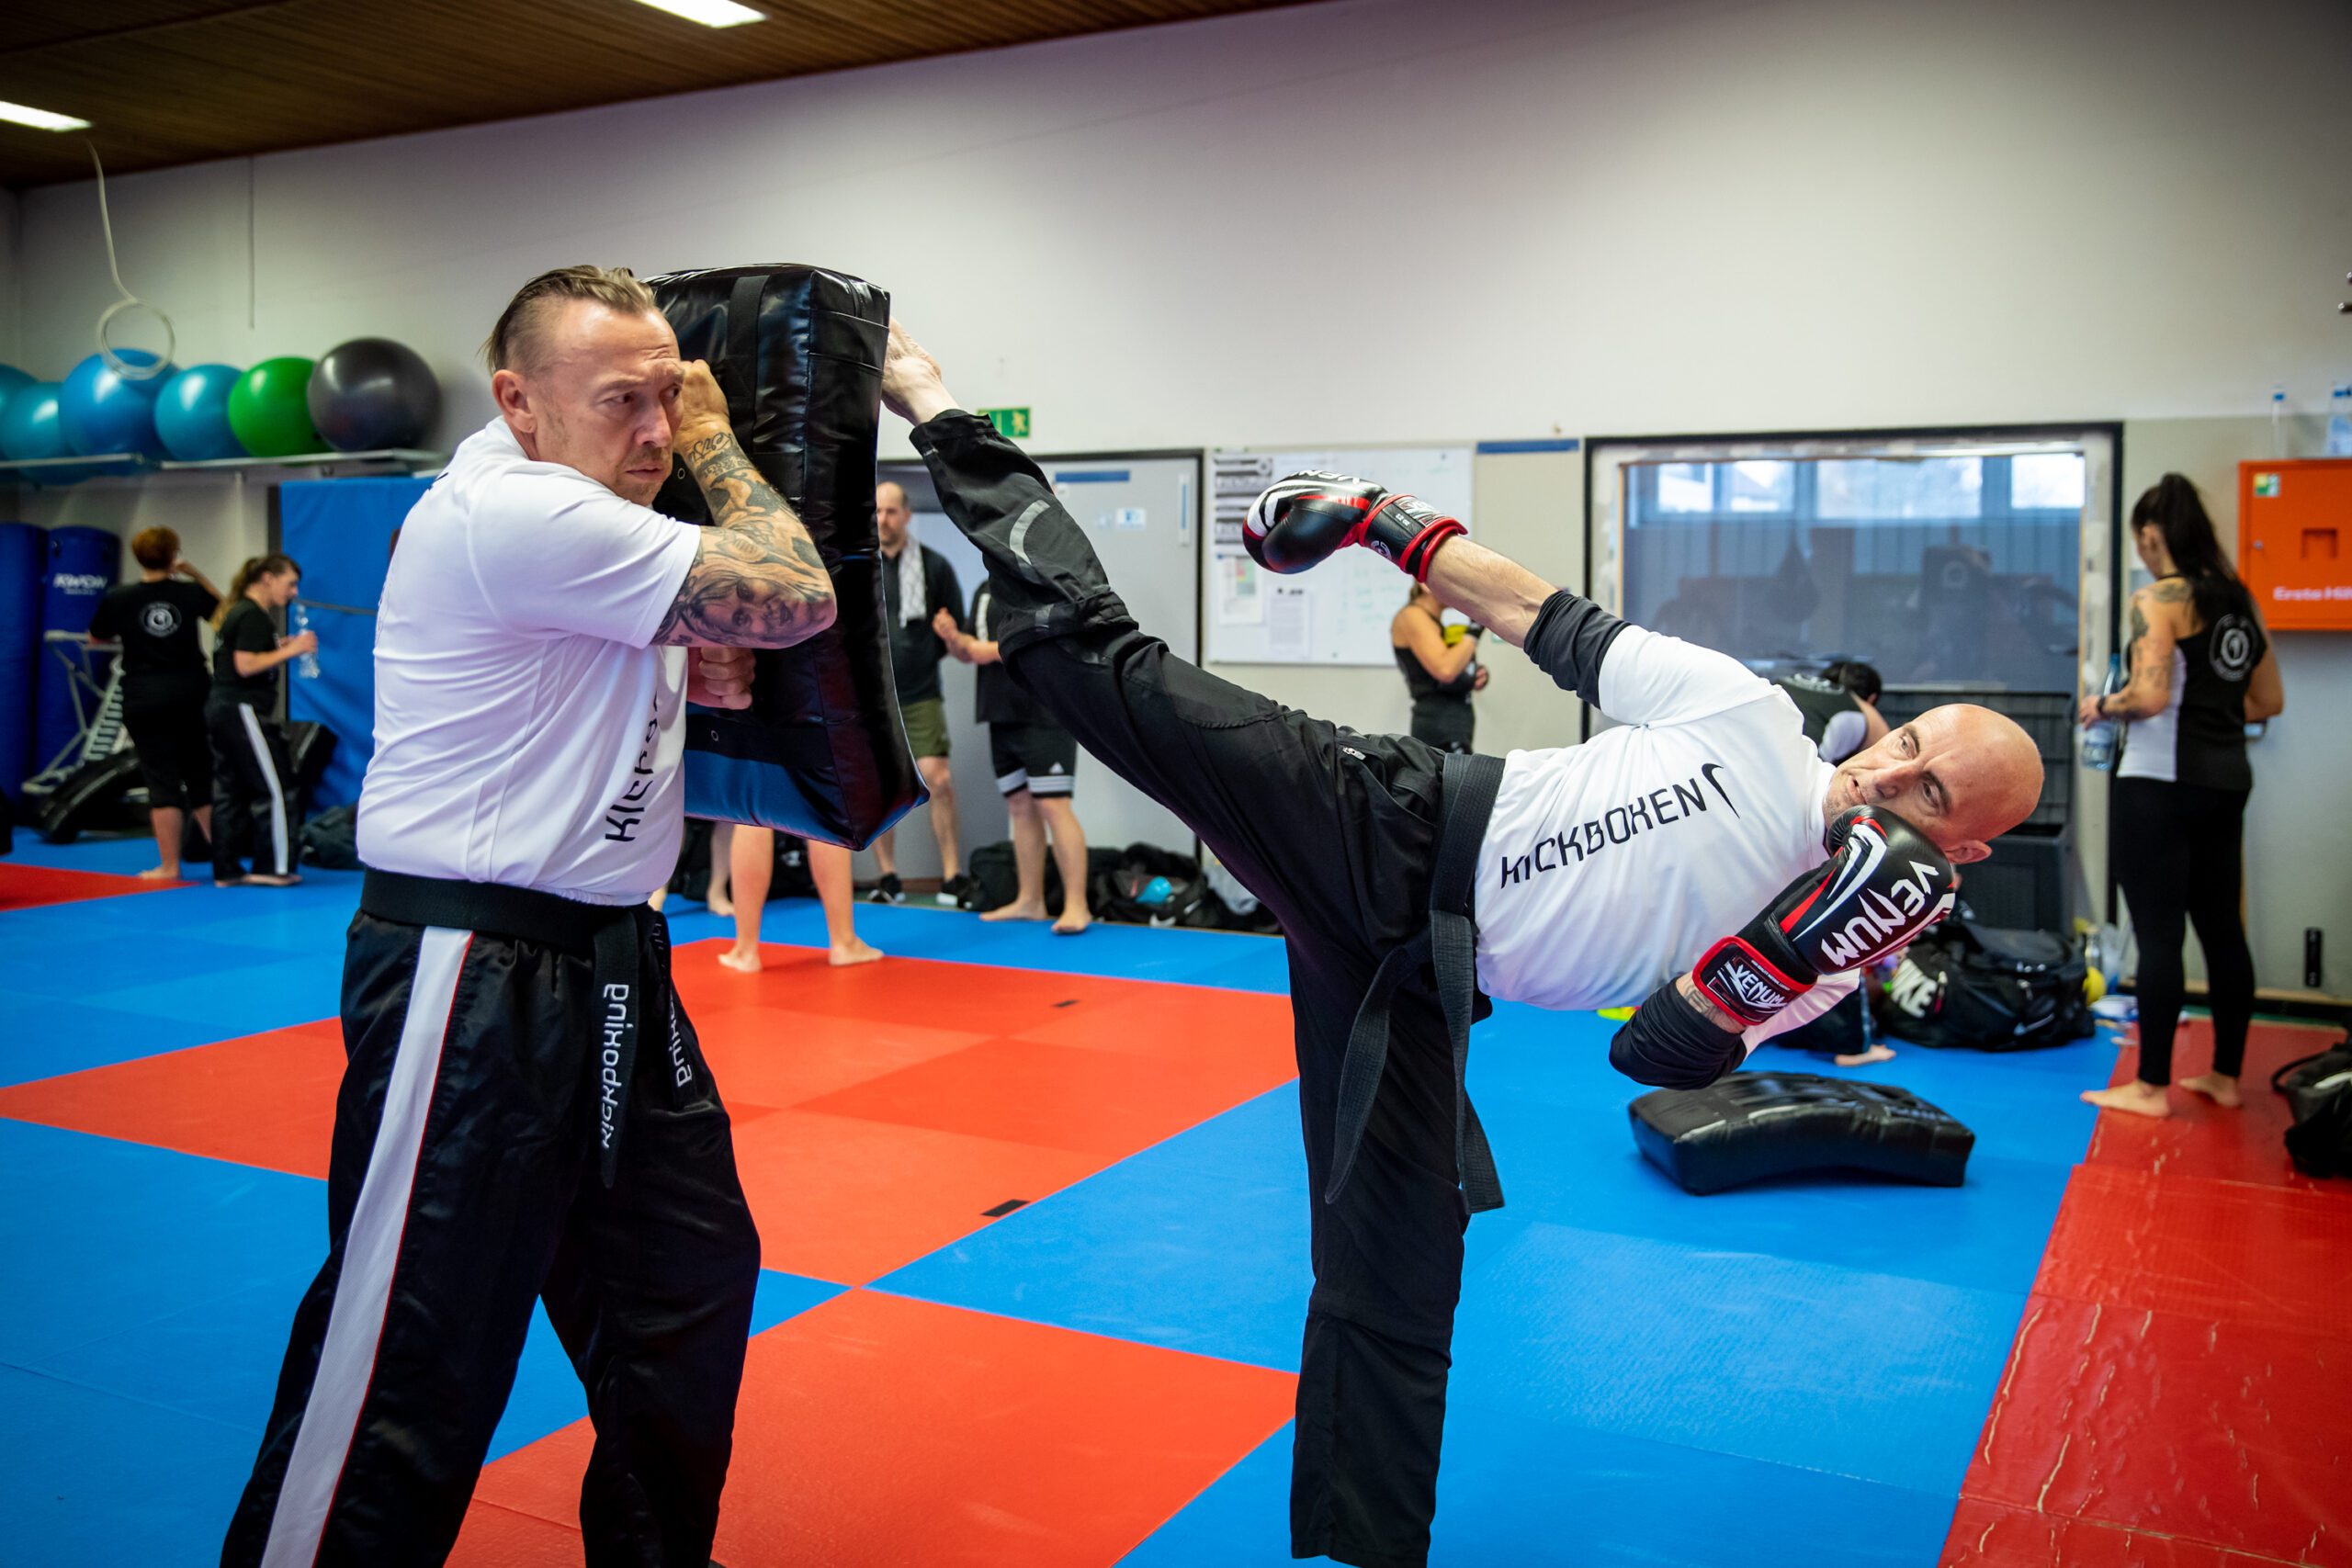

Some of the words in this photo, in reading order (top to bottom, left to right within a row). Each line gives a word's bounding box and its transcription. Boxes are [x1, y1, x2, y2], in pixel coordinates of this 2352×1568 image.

[53, 573, 107, 589] KWON
[2273, 586, 2323, 602] Erste
[1500, 777, 1708, 889] KICKBOXEN
[1821, 860, 1939, 967] VENUM
[1724, 960, 1788, 1009] VENUM
